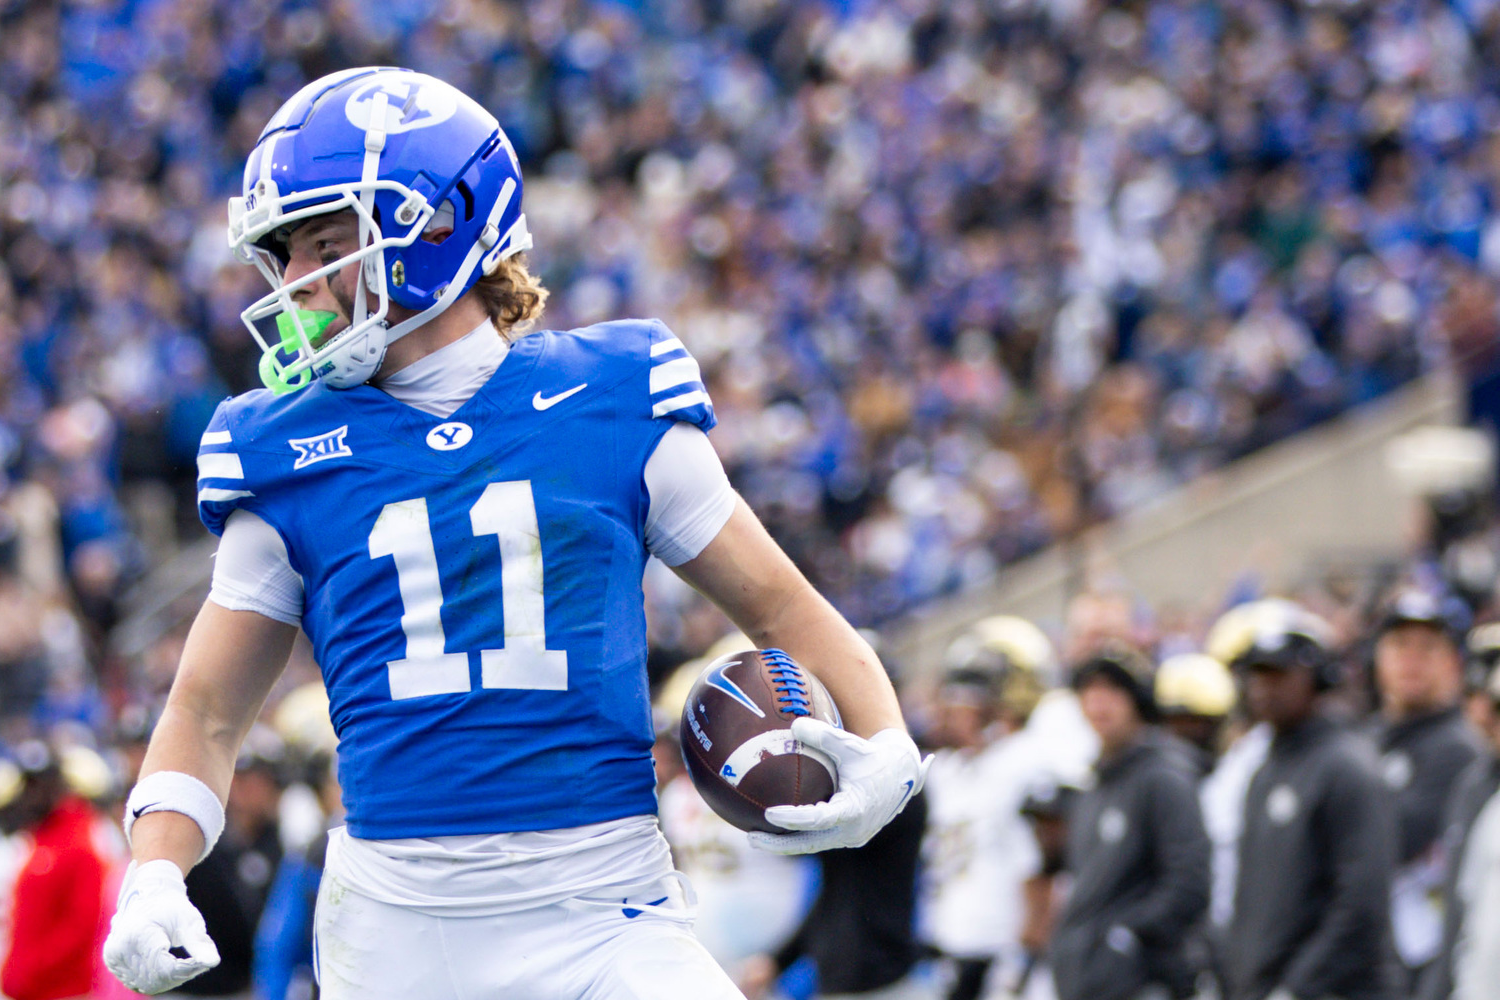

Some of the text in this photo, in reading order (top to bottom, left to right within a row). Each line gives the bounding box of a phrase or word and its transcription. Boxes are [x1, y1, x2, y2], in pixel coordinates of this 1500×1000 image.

[291, 427, 351, 468] XII
[434, 427, 462, 446] Y
[369, 480, 567, 700] 11
